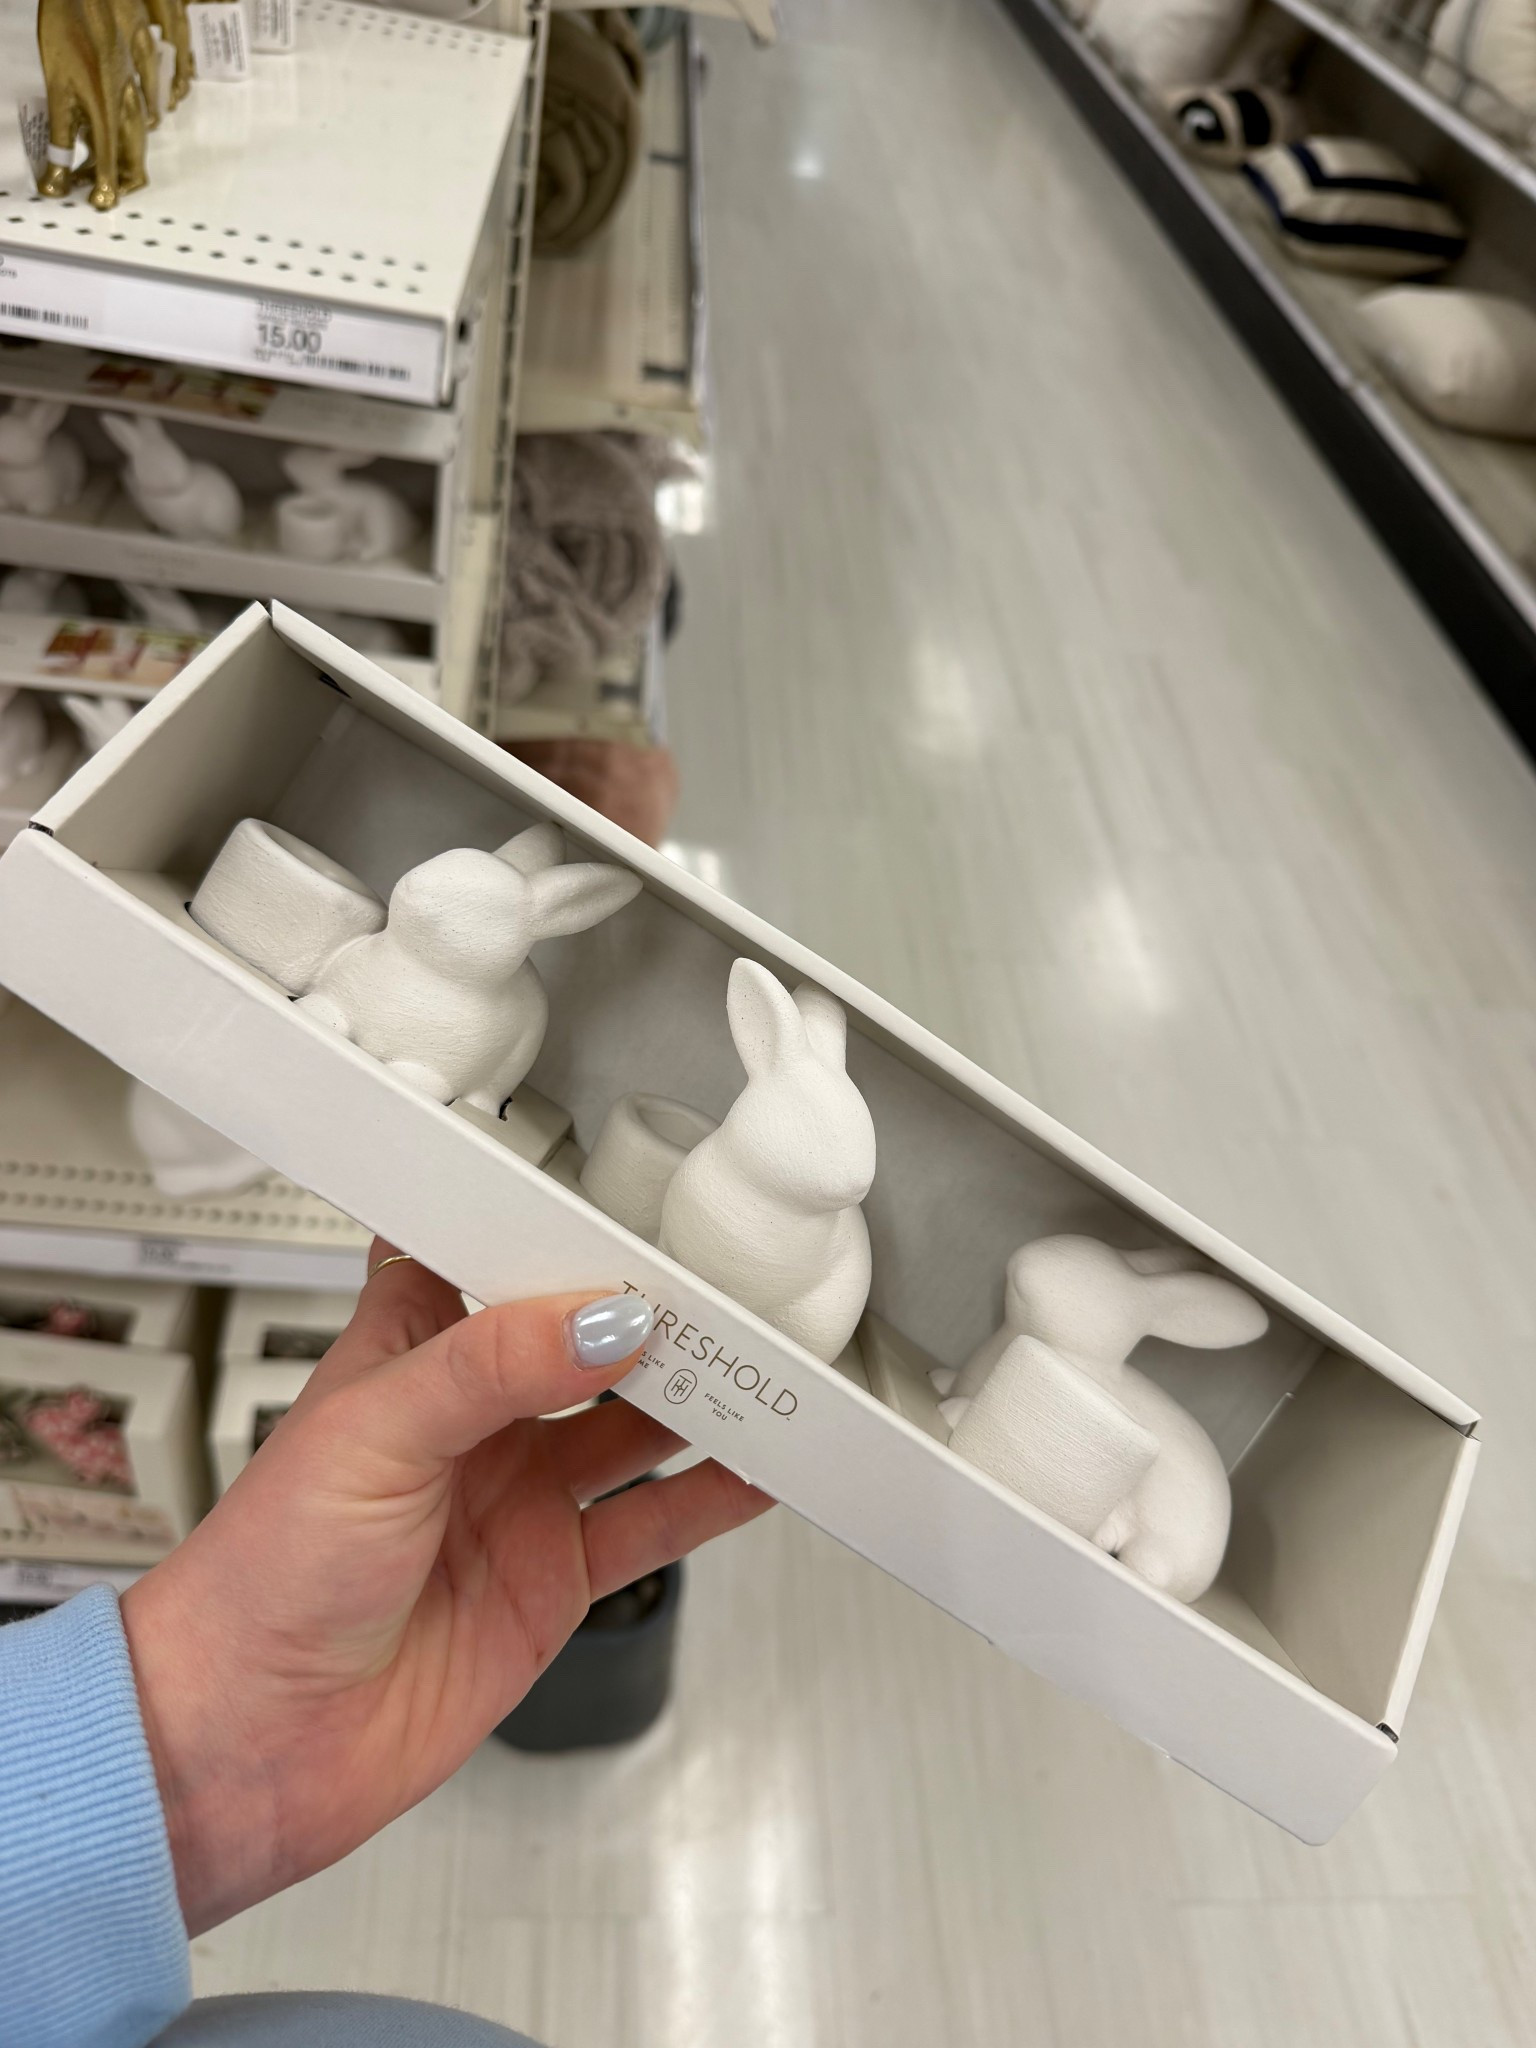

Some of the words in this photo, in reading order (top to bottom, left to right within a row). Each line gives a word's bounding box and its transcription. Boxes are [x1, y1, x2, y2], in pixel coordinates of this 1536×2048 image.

[258, 323, 322, 354] 15.00
[623, 1280, 798, 1416] TRESHOLD
[637, 1359, 650, 1369] ME
[647, 1354, 666, 1369] LIKE
[704, 1393, 727, 1410] FEELS
[727, 1408, 745, 1422] LIKE
[712, 1408, 728, 1421] YOU
